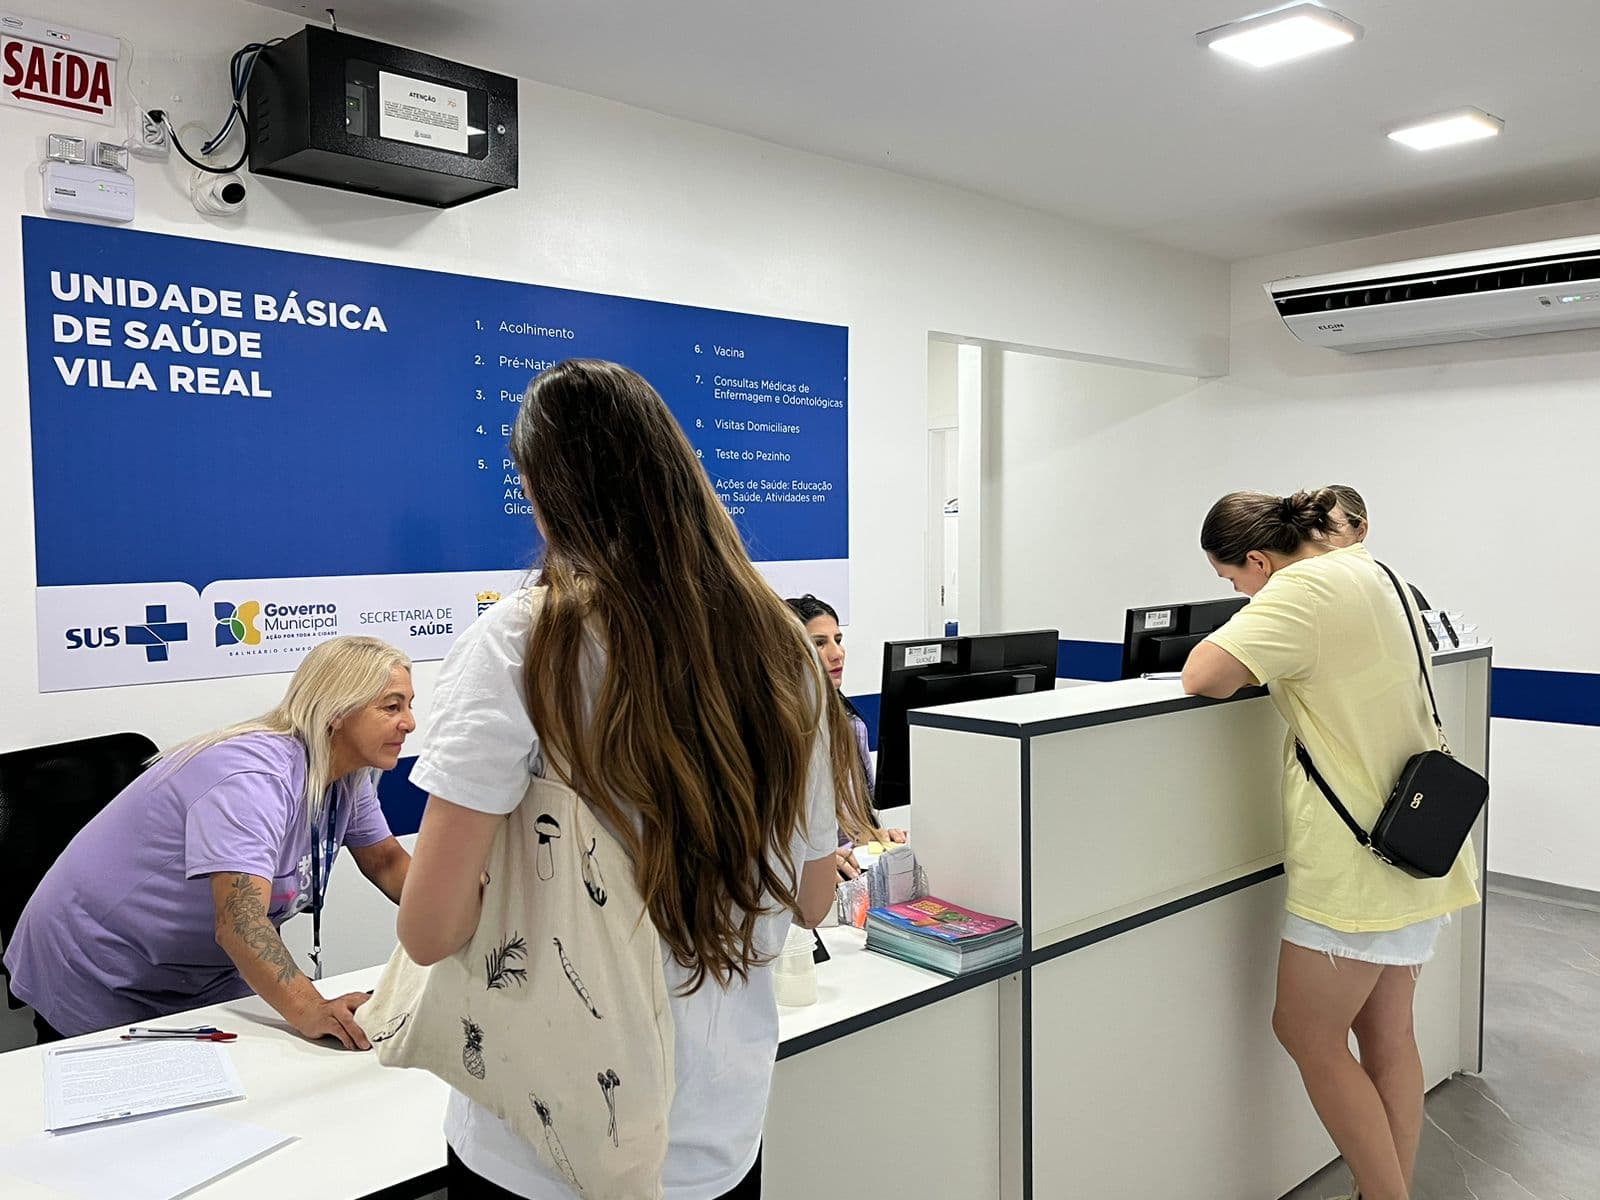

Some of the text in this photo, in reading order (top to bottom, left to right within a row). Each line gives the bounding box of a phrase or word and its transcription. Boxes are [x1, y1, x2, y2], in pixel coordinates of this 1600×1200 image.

[409, 91, 436, 103] ATENÇÃO
[50, 271, 388, 333] UNIDADE BÁSICA
[53, 314, 262, 359] DE SAÚDE
[475, 320, 575, 339] 1. Acolhimento
[694, 344, 745, 359] 6. Vacina
[474, 355, 485, 366] 2.
[53, 356, 272, 398] VILA REAL
[695, 375, 810, 394] 7. Consultas Médicas de
[475, 390, 525, 403] 3. Pue
[714, 389, 844, 409] Enfermagem e Odontológicas
[476, 425, 488, 435] 4.
[696, 418, 801, 434] 8. Visitas Domiciliares
[696, 449, 791, 462] 9. Teste do Pezinho
[477, 459, 489, 470] 5.
[715, 479, 833, 493] Ações de Saúde: Educação
[733, 491, 763, 503] Saúde,
[765, 493, 810, 503] Atividades
[812, 494, 826, 503] em
[504, 503, 535, 515] Glice
[264, 603, 337, 617] Governo
[359, 608, 453, 625] SECRETARIA DE
[264, 615, 338, 631] Municipal
[410, 621, 454, 636] SAÚDE
[65, 626, 120, 650] SUS
[229, 648, 278, 657] BALNEÁRIO
